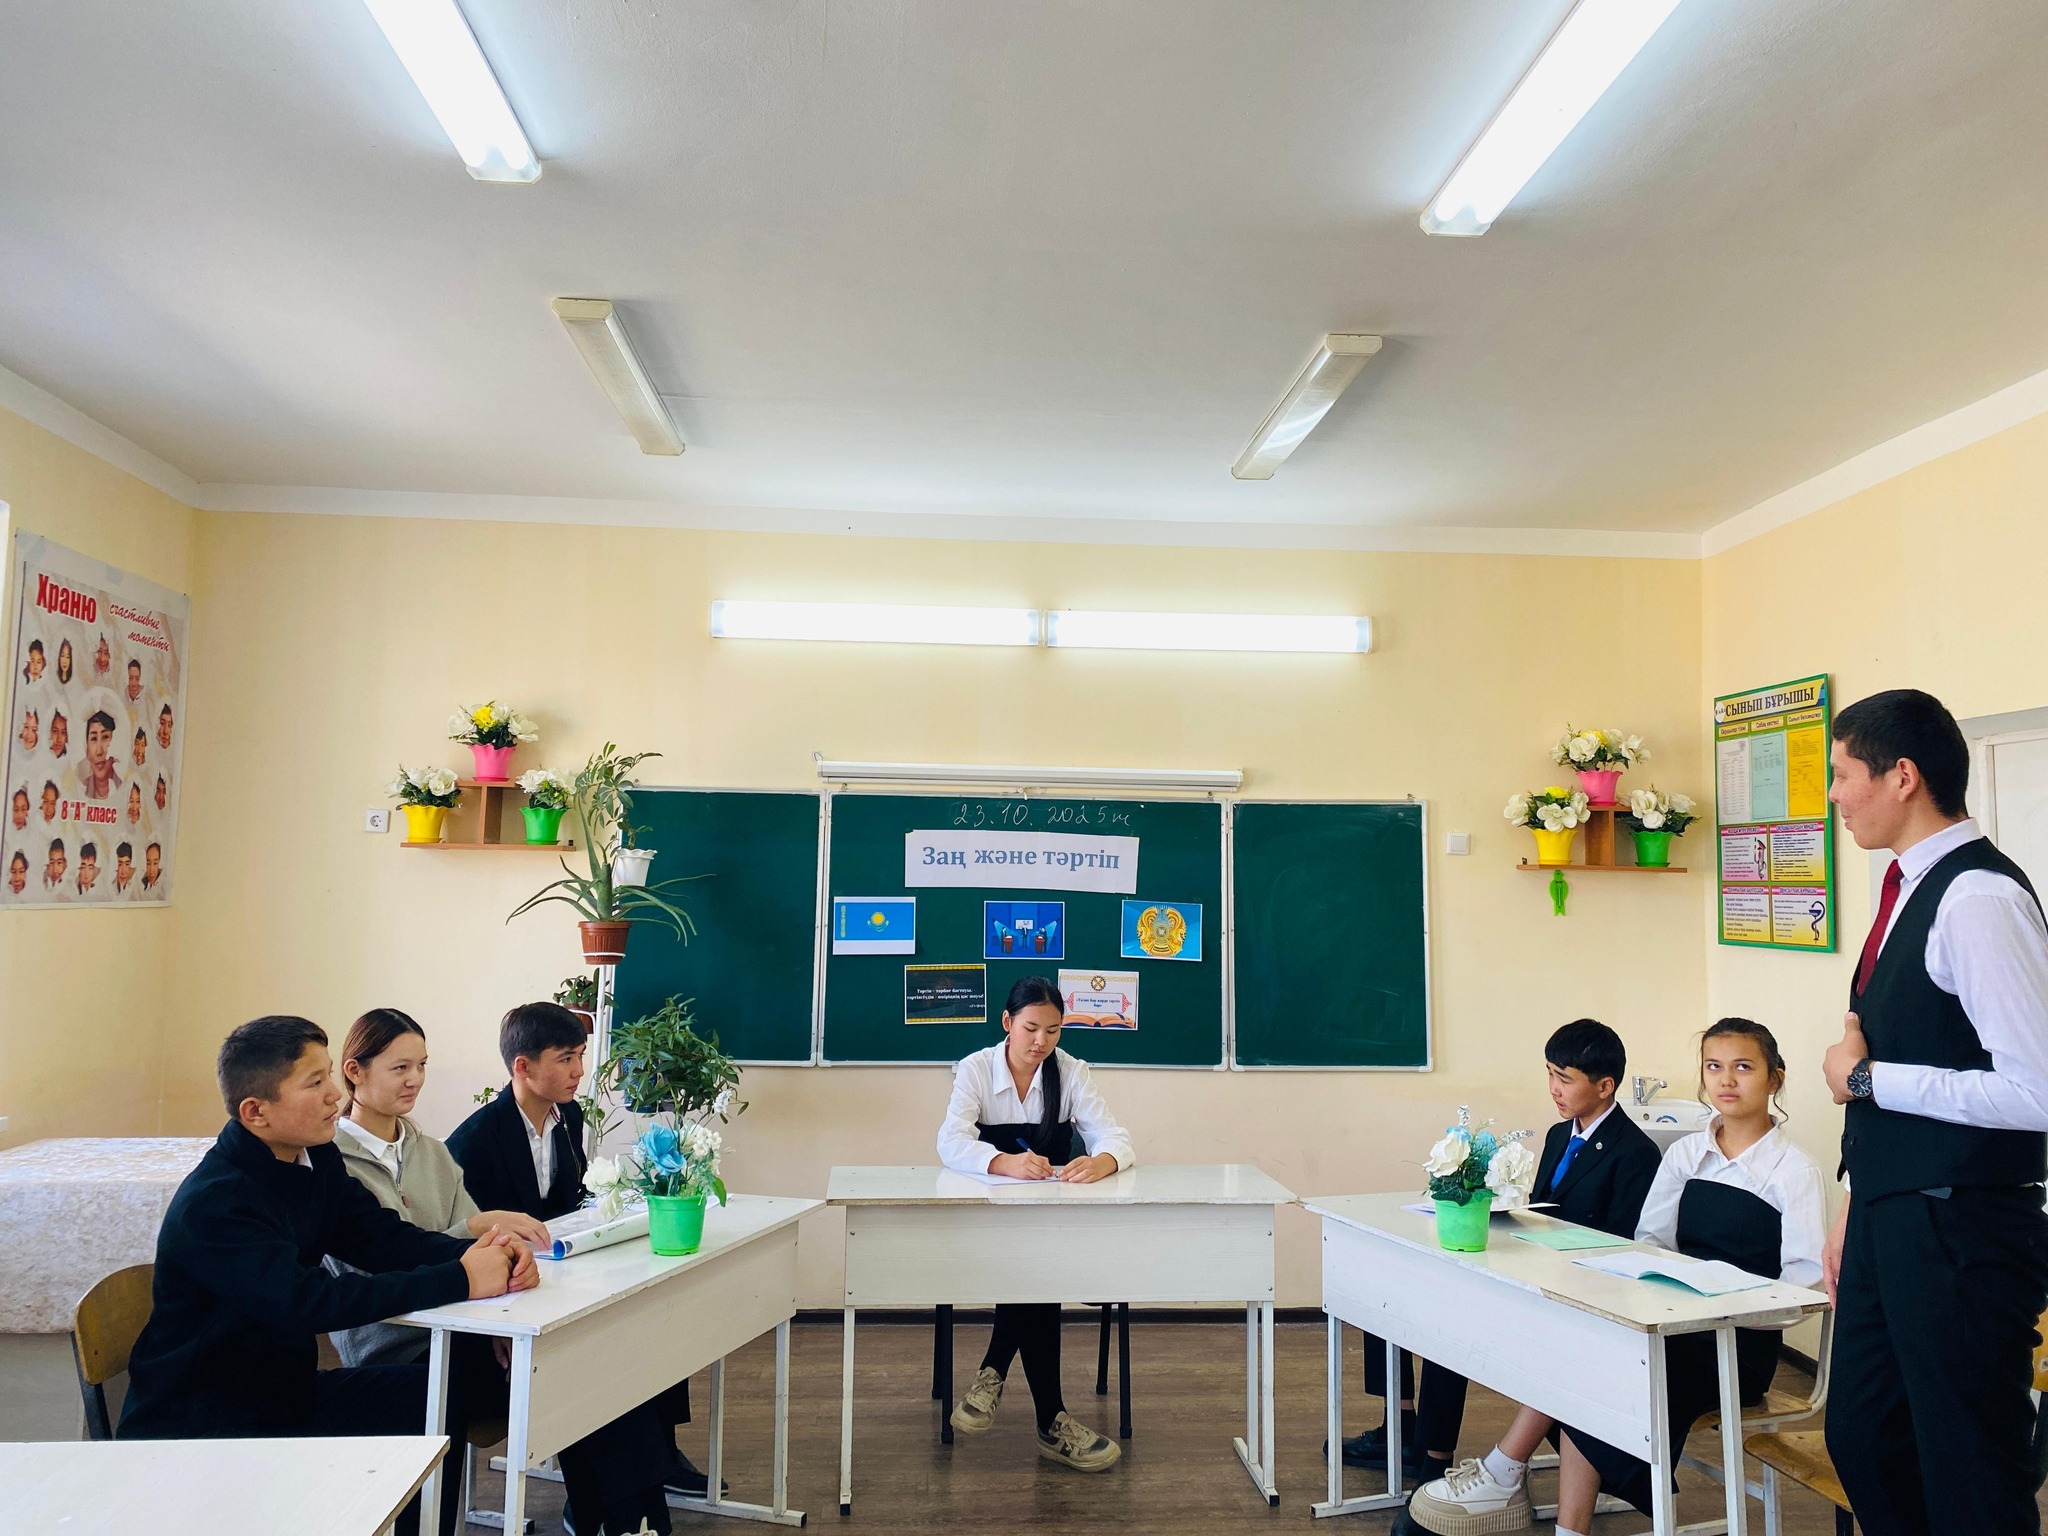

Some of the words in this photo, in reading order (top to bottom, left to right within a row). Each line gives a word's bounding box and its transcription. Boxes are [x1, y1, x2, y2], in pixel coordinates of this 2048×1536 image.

[36, 573, 97, 623] Храню
[109, 603, 160, 630] счастливые
[127, 631, 170, 652] моменты
[1725, 698, 1762, 717] СЫНЫП
[1765, 687, 1815, 708] БҰРЫШЫ
[61, 800, 68, 820] 8
[86, 806, 117, 824] класс
[922, 846, 966, 870] Заң
[974, 848, 1037, 865] және
[1042, 849, 1120, 871] тәртіп
